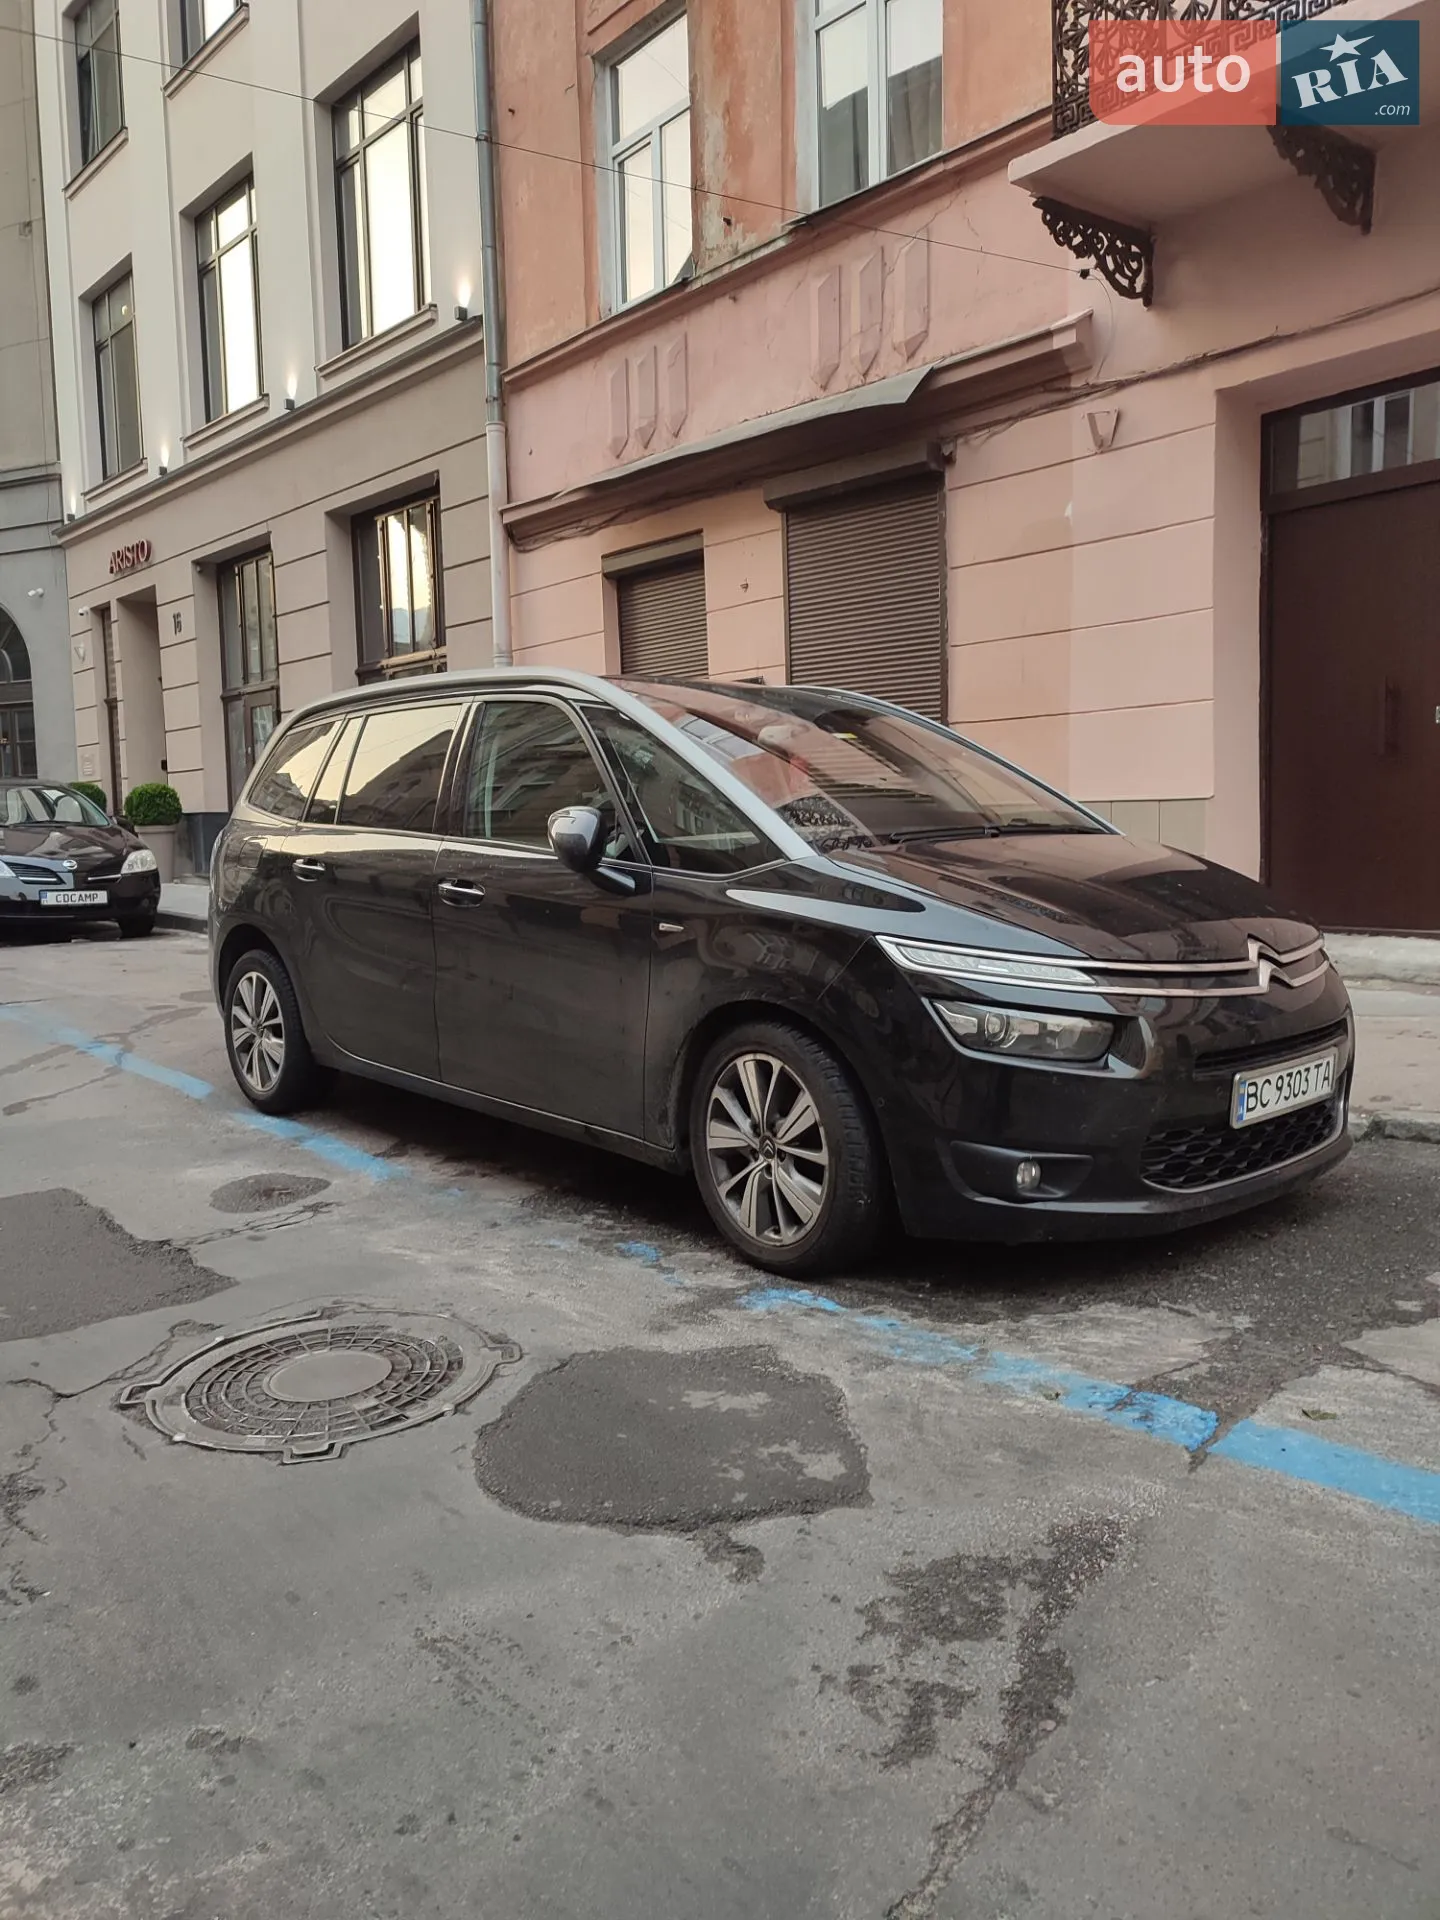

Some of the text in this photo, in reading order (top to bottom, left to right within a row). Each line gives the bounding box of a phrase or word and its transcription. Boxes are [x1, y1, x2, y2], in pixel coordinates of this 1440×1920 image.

[109, 539, 151, 574] ARISTO
[172, 612, 182, 635] 16
[1246, 1060, 1331, 1112] BC 9303 TA
